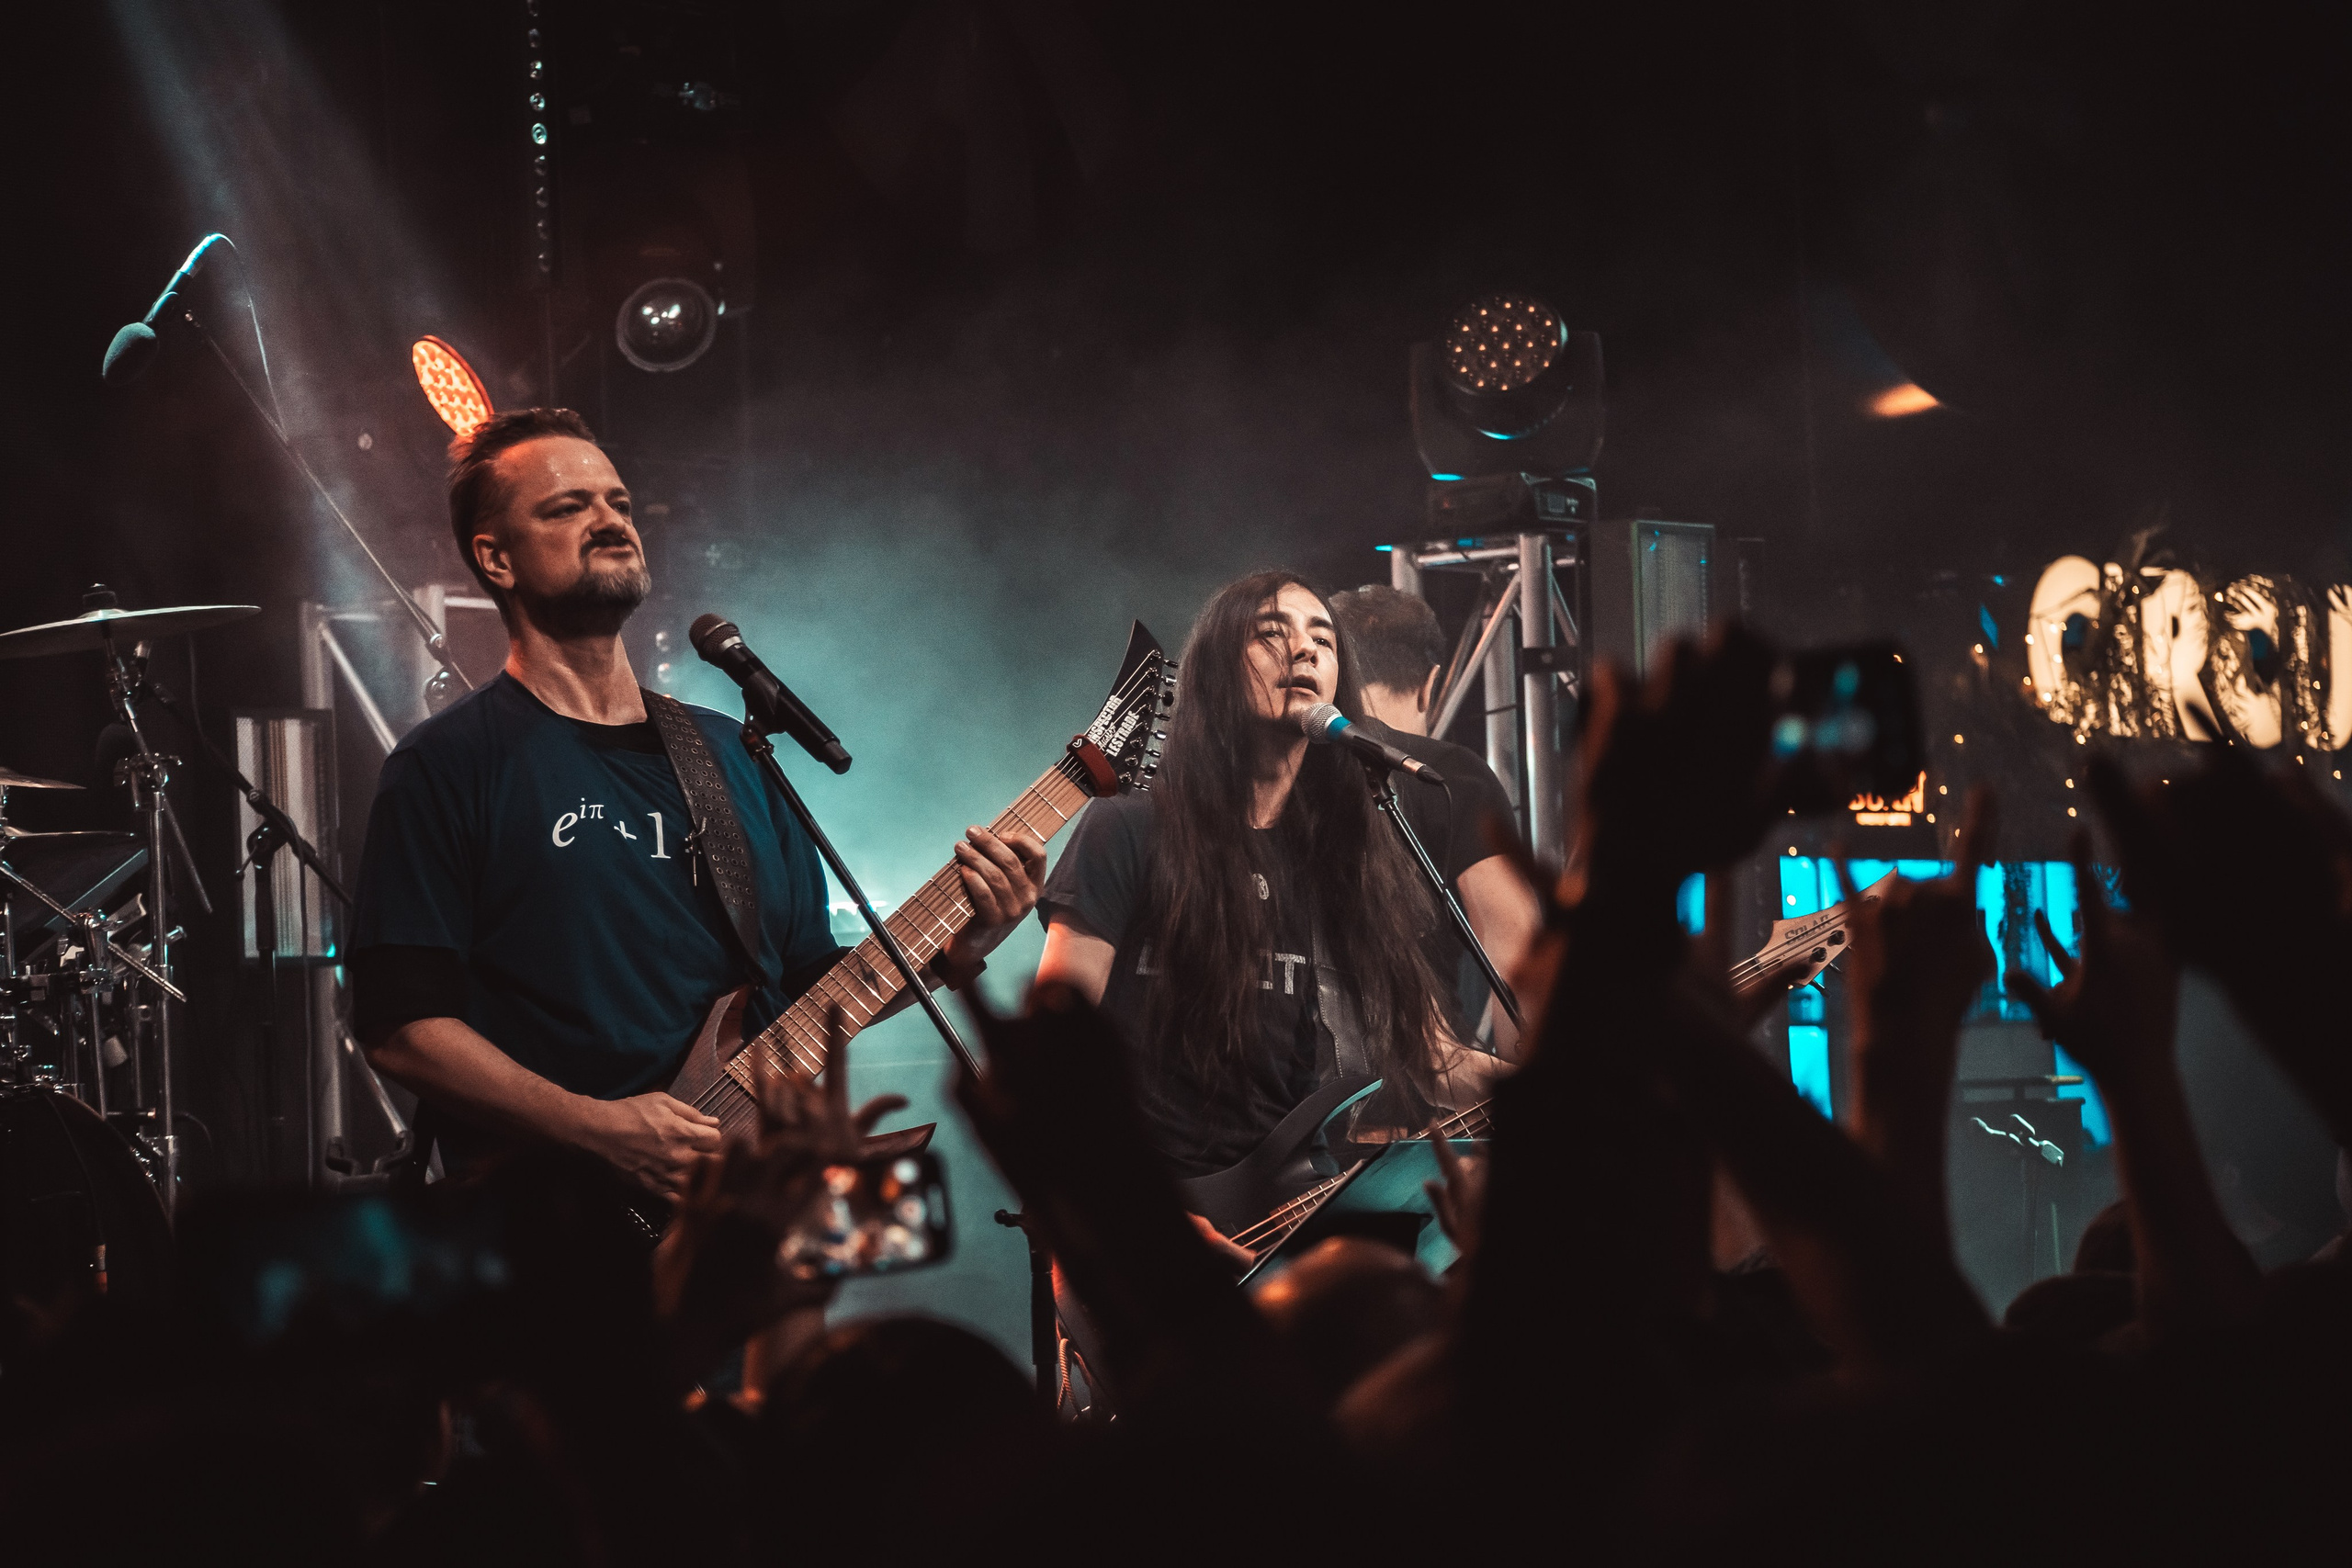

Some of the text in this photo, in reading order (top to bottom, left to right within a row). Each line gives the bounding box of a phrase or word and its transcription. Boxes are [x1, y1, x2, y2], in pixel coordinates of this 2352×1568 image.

[1087, 694, 1123, 745] INSPECTOR
[1105, 710, 1140, 757] LESTRADE
[1784, 913, 1833, 946] SOLAR
